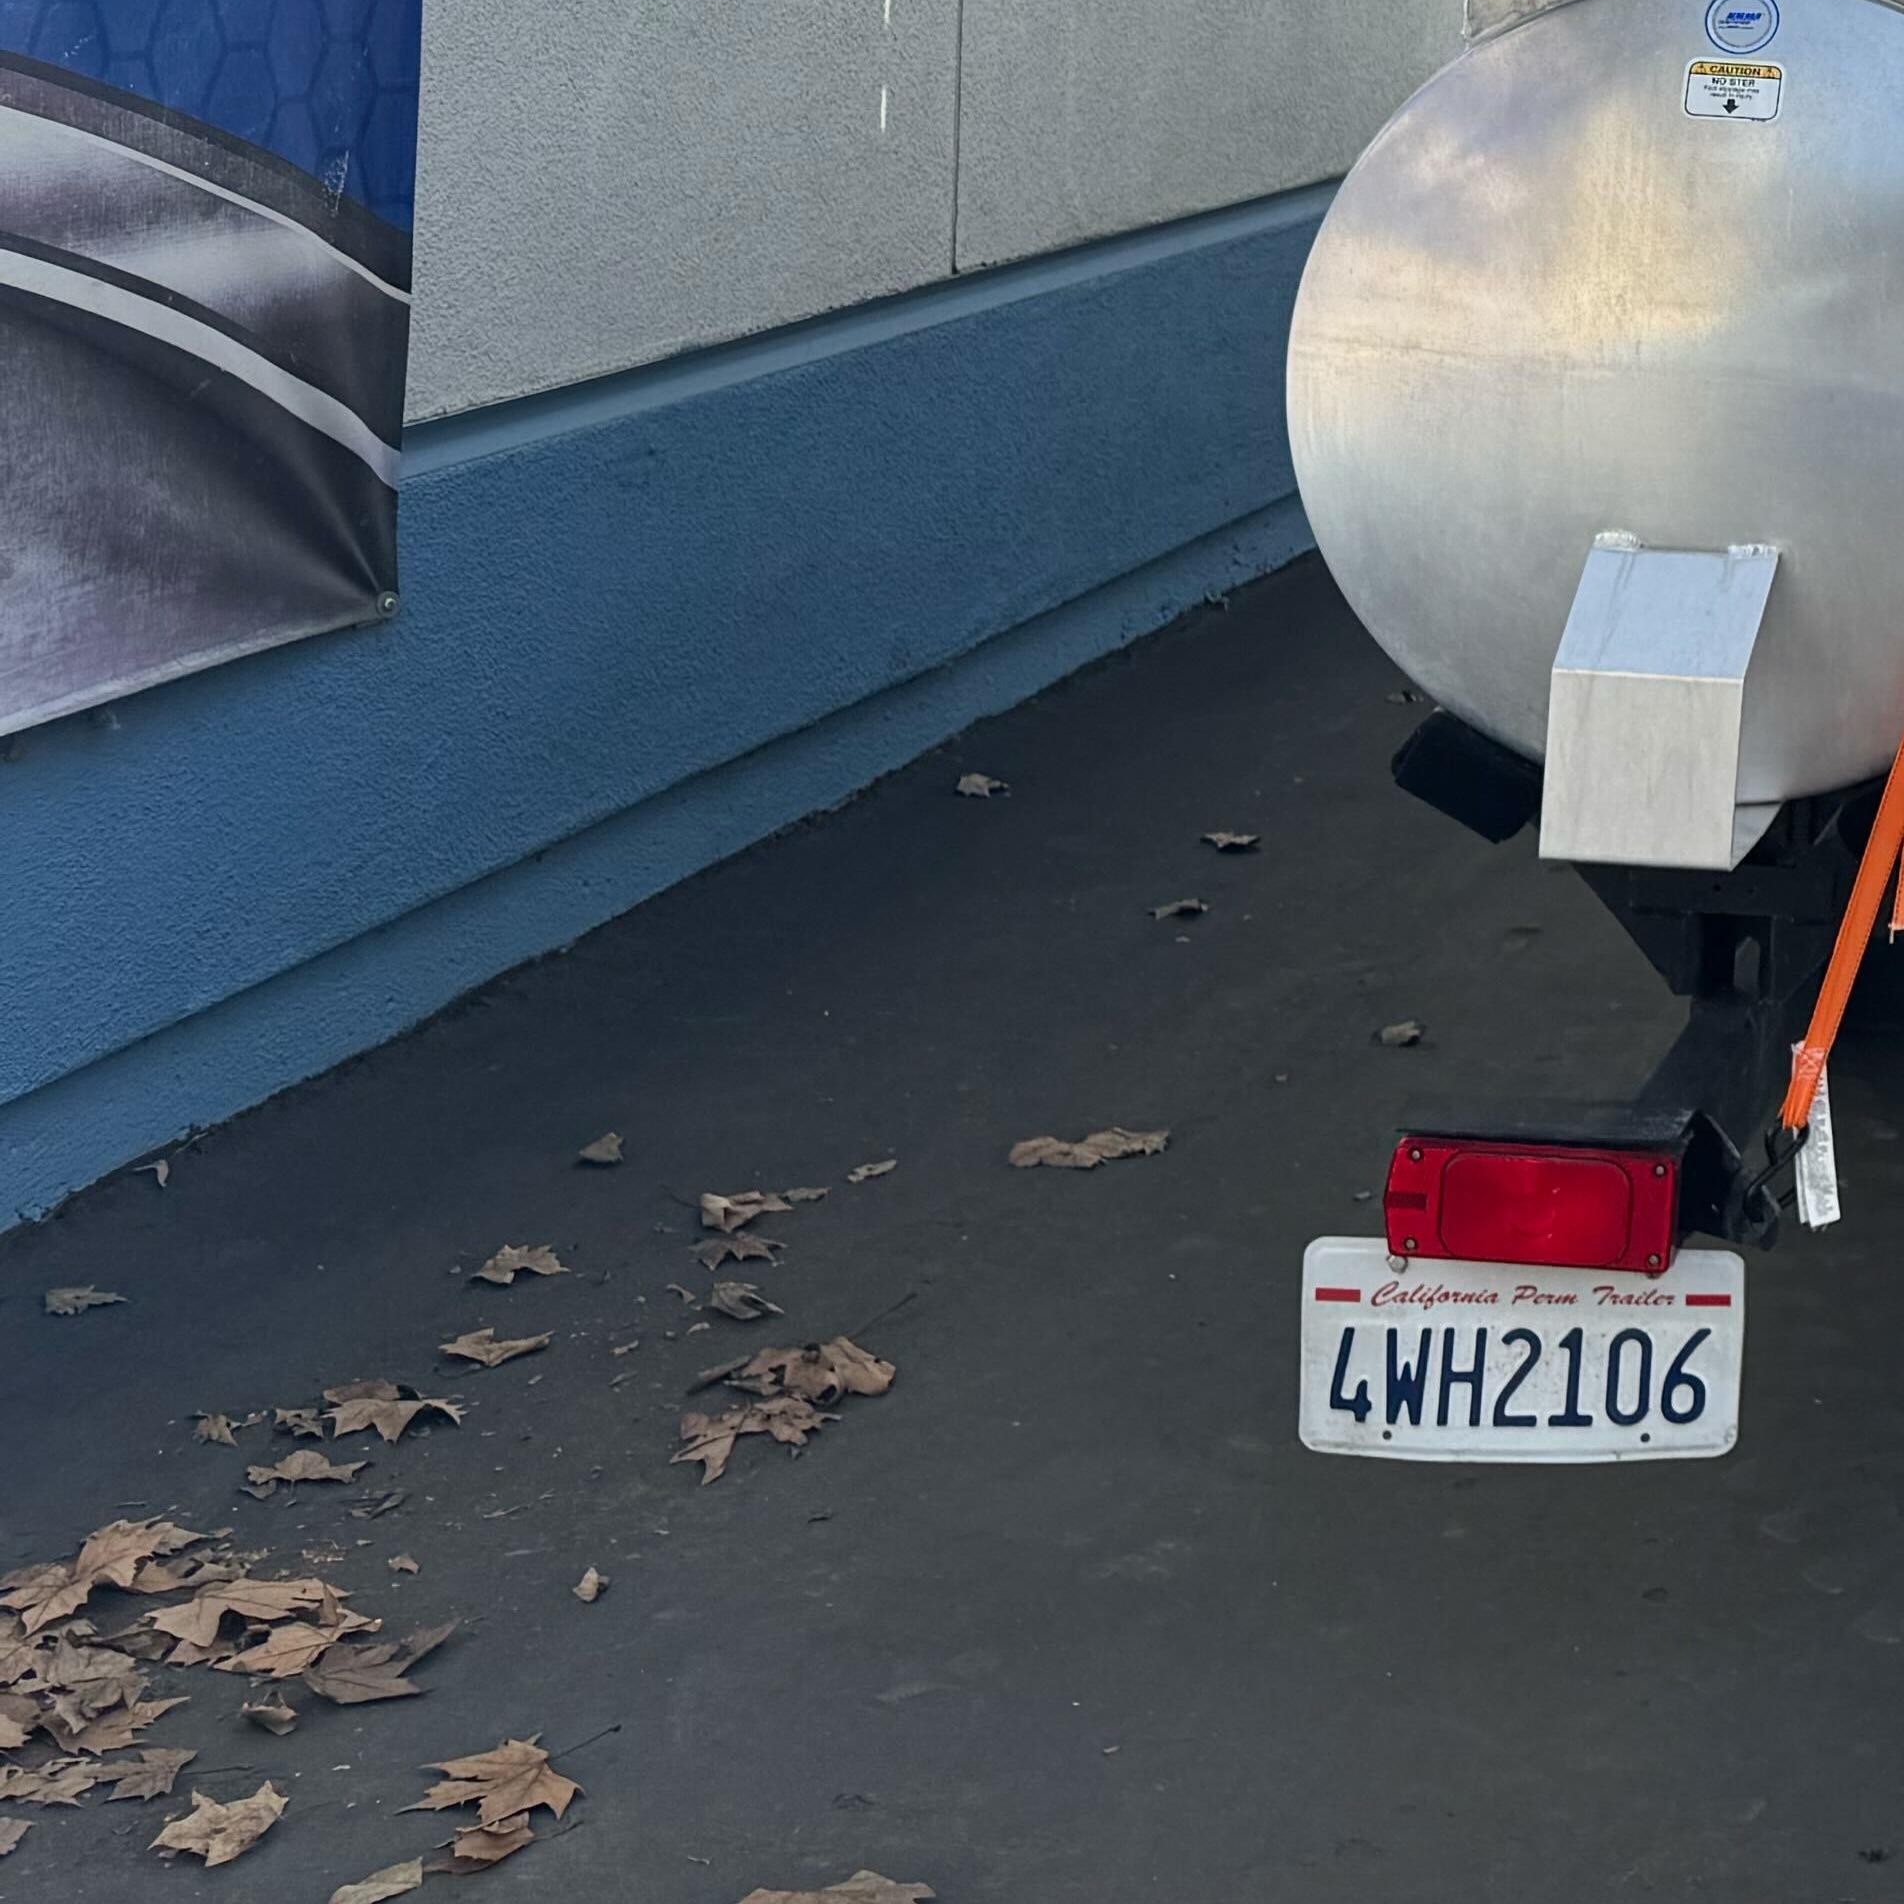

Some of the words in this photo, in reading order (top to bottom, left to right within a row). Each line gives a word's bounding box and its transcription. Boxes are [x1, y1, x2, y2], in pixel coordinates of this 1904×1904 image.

[1709, 65, 1761, 76] CAUTION
[1371, 1280, 1499, 1310] California
[1511, 1284, 1579, 1306] Perm
[1592, 1285, 1676, 1307] Trailer
[1329, 1326, 1712, 1427] 4WH2106
